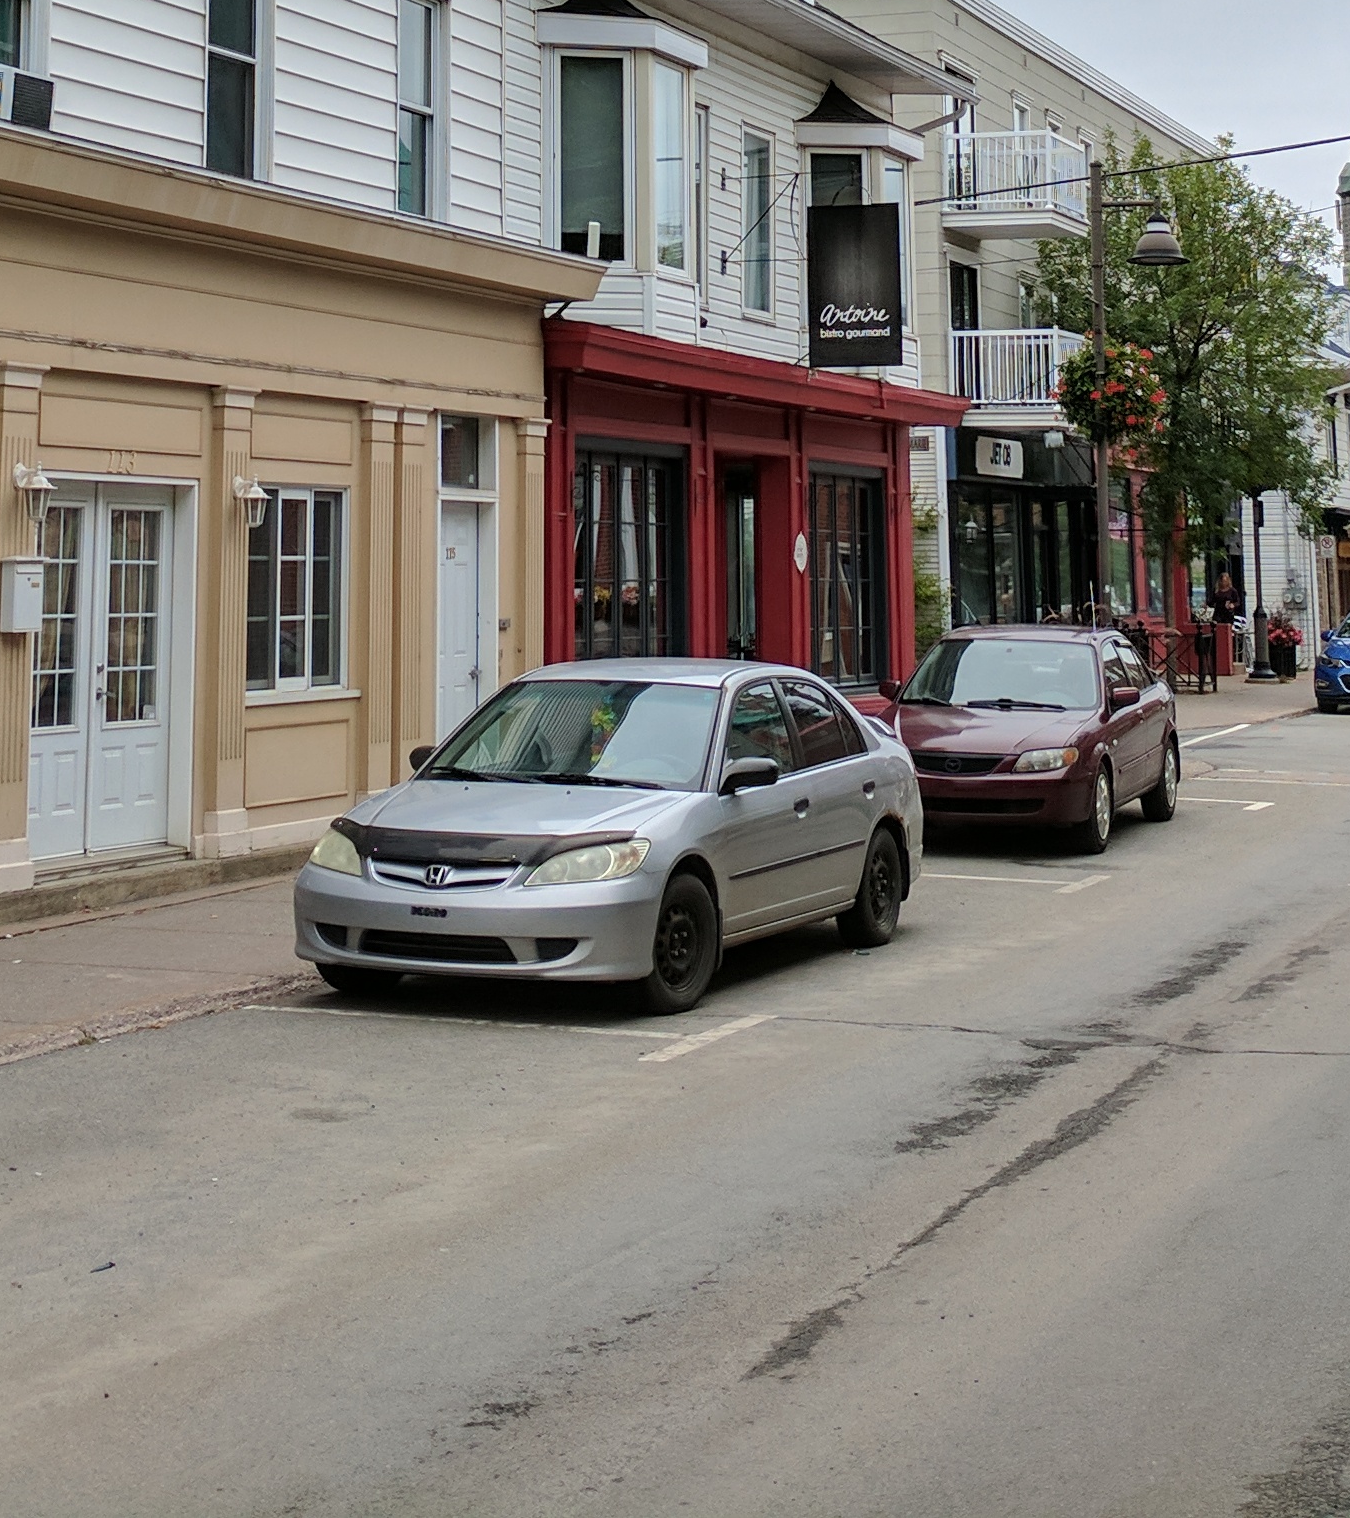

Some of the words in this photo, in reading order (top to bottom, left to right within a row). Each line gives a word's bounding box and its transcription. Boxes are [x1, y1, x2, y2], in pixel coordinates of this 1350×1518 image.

[820, 328, 845, 339] bistro
[845, 326, 891, 340] gourmand
[107, 451, 138, 475] 113
